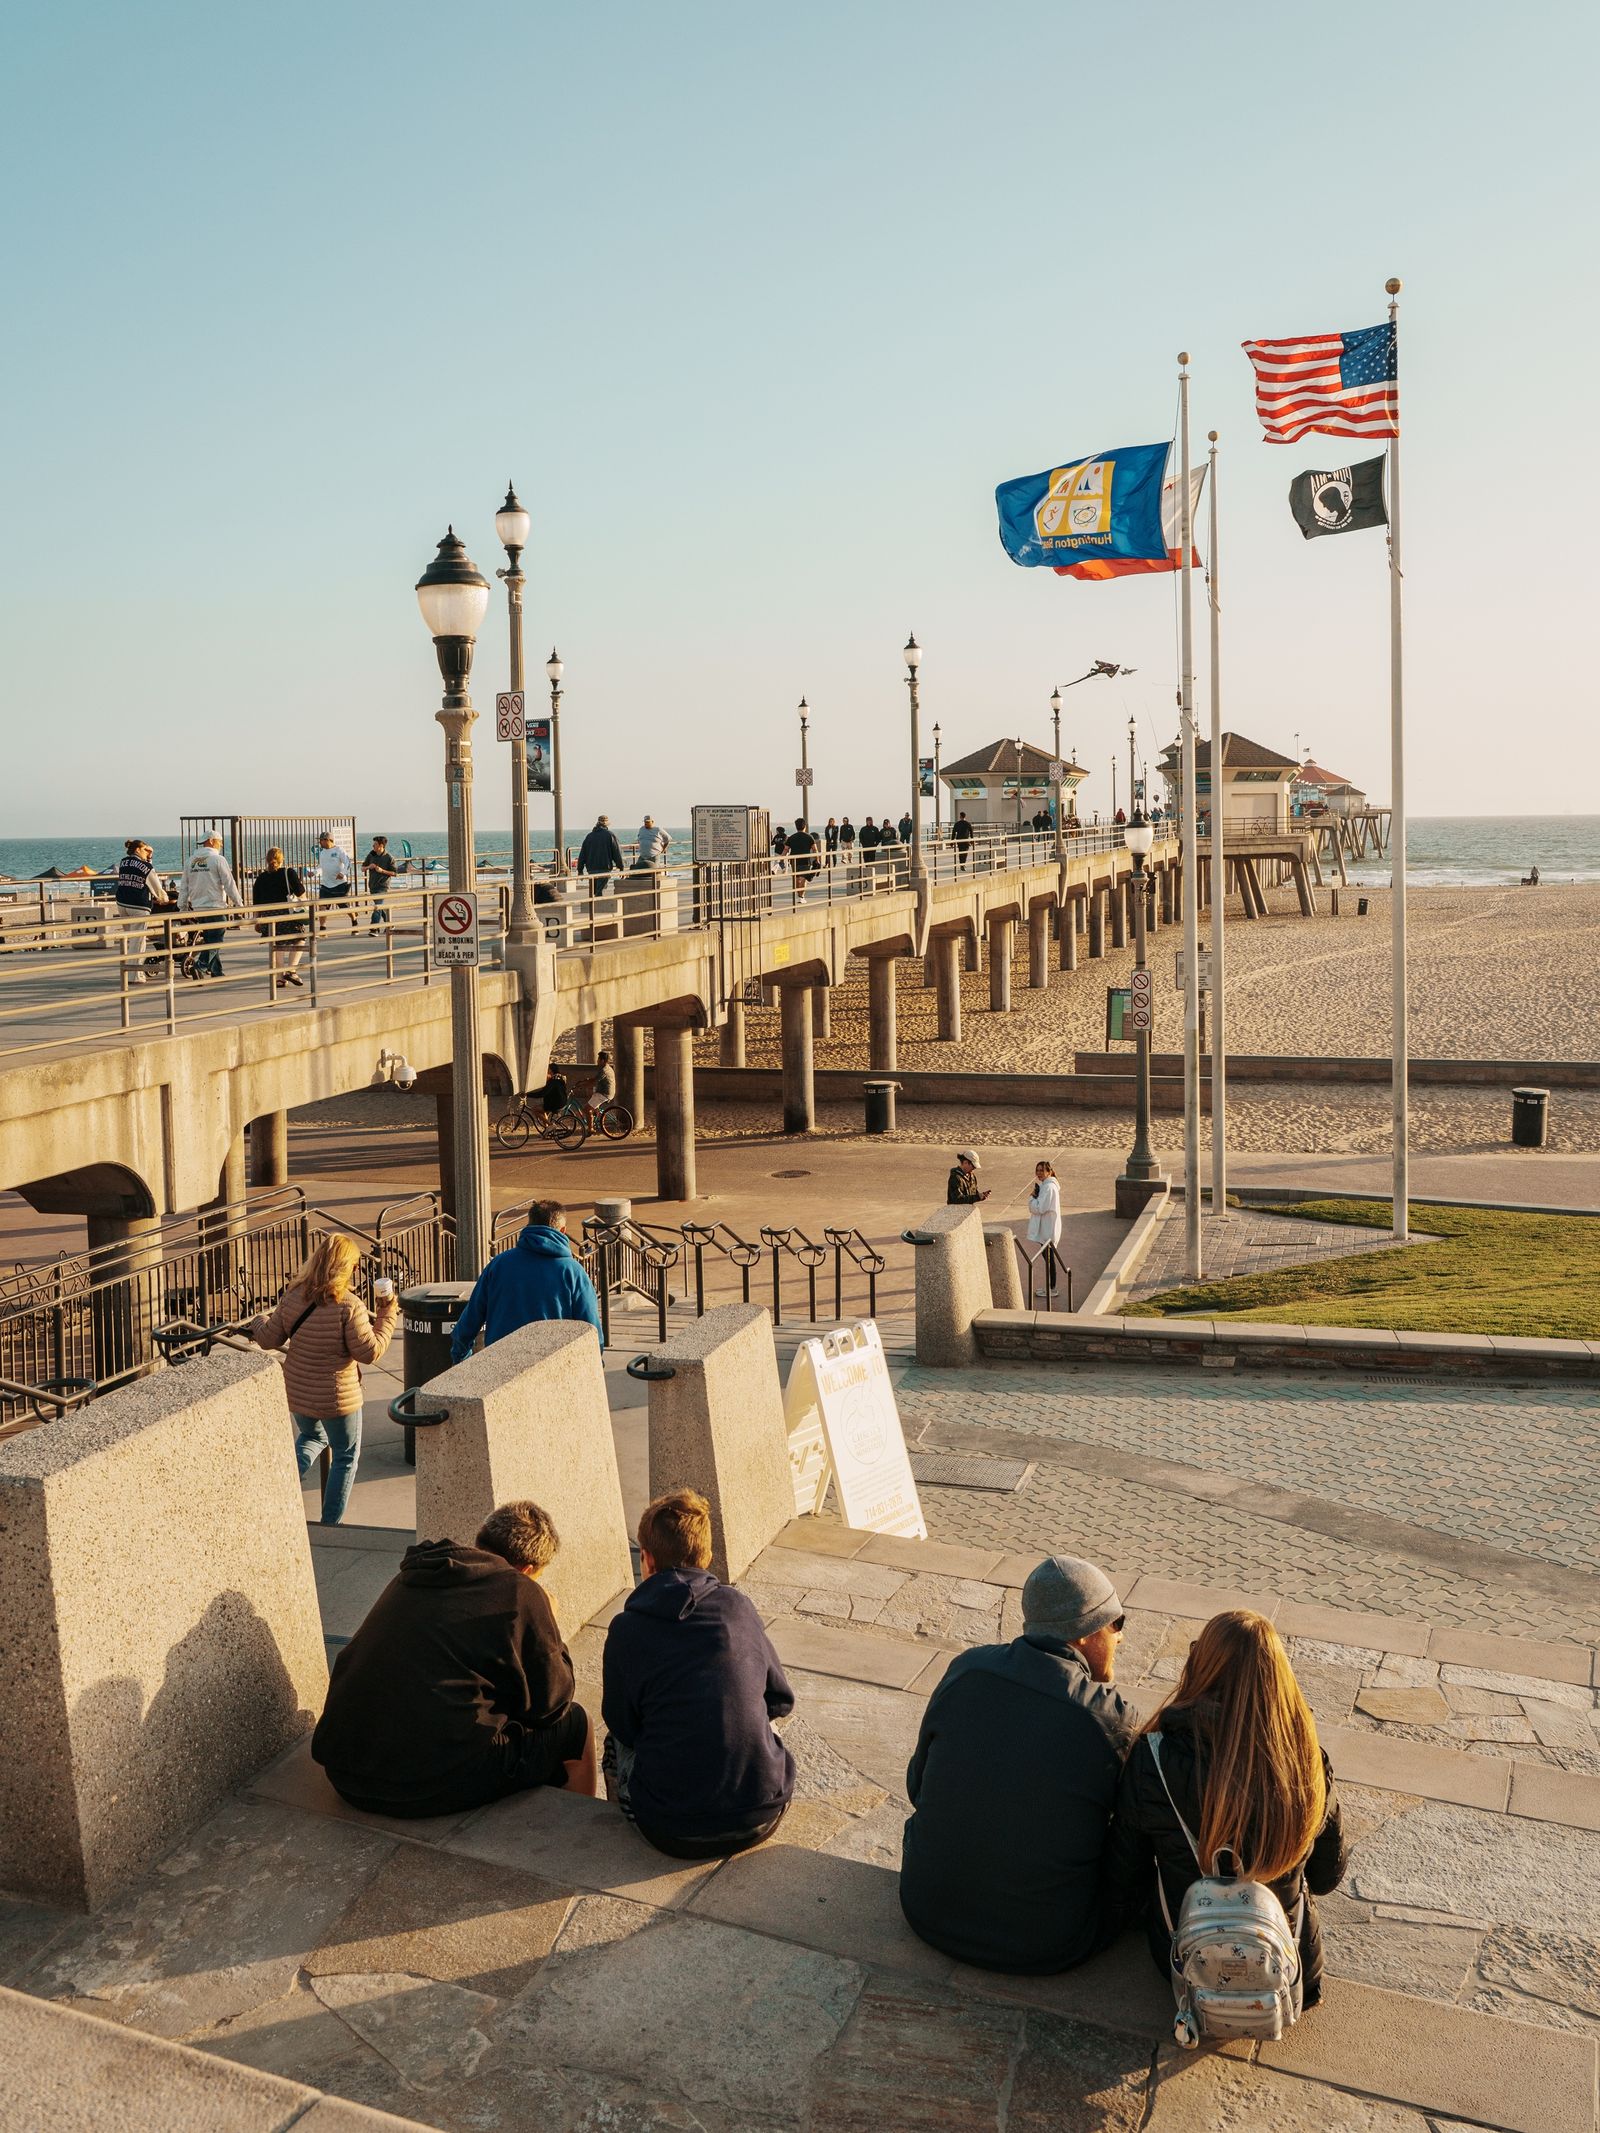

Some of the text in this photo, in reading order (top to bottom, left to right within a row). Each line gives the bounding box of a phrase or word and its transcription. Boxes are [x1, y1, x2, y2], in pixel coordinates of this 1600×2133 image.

[438, 936, 474, 944] NO SMOKING
[438, 951, 456, 959] BEACH
[462, 951, 475, 959] PIER
[821, 1355, 884, 1396] WELCOME TO
